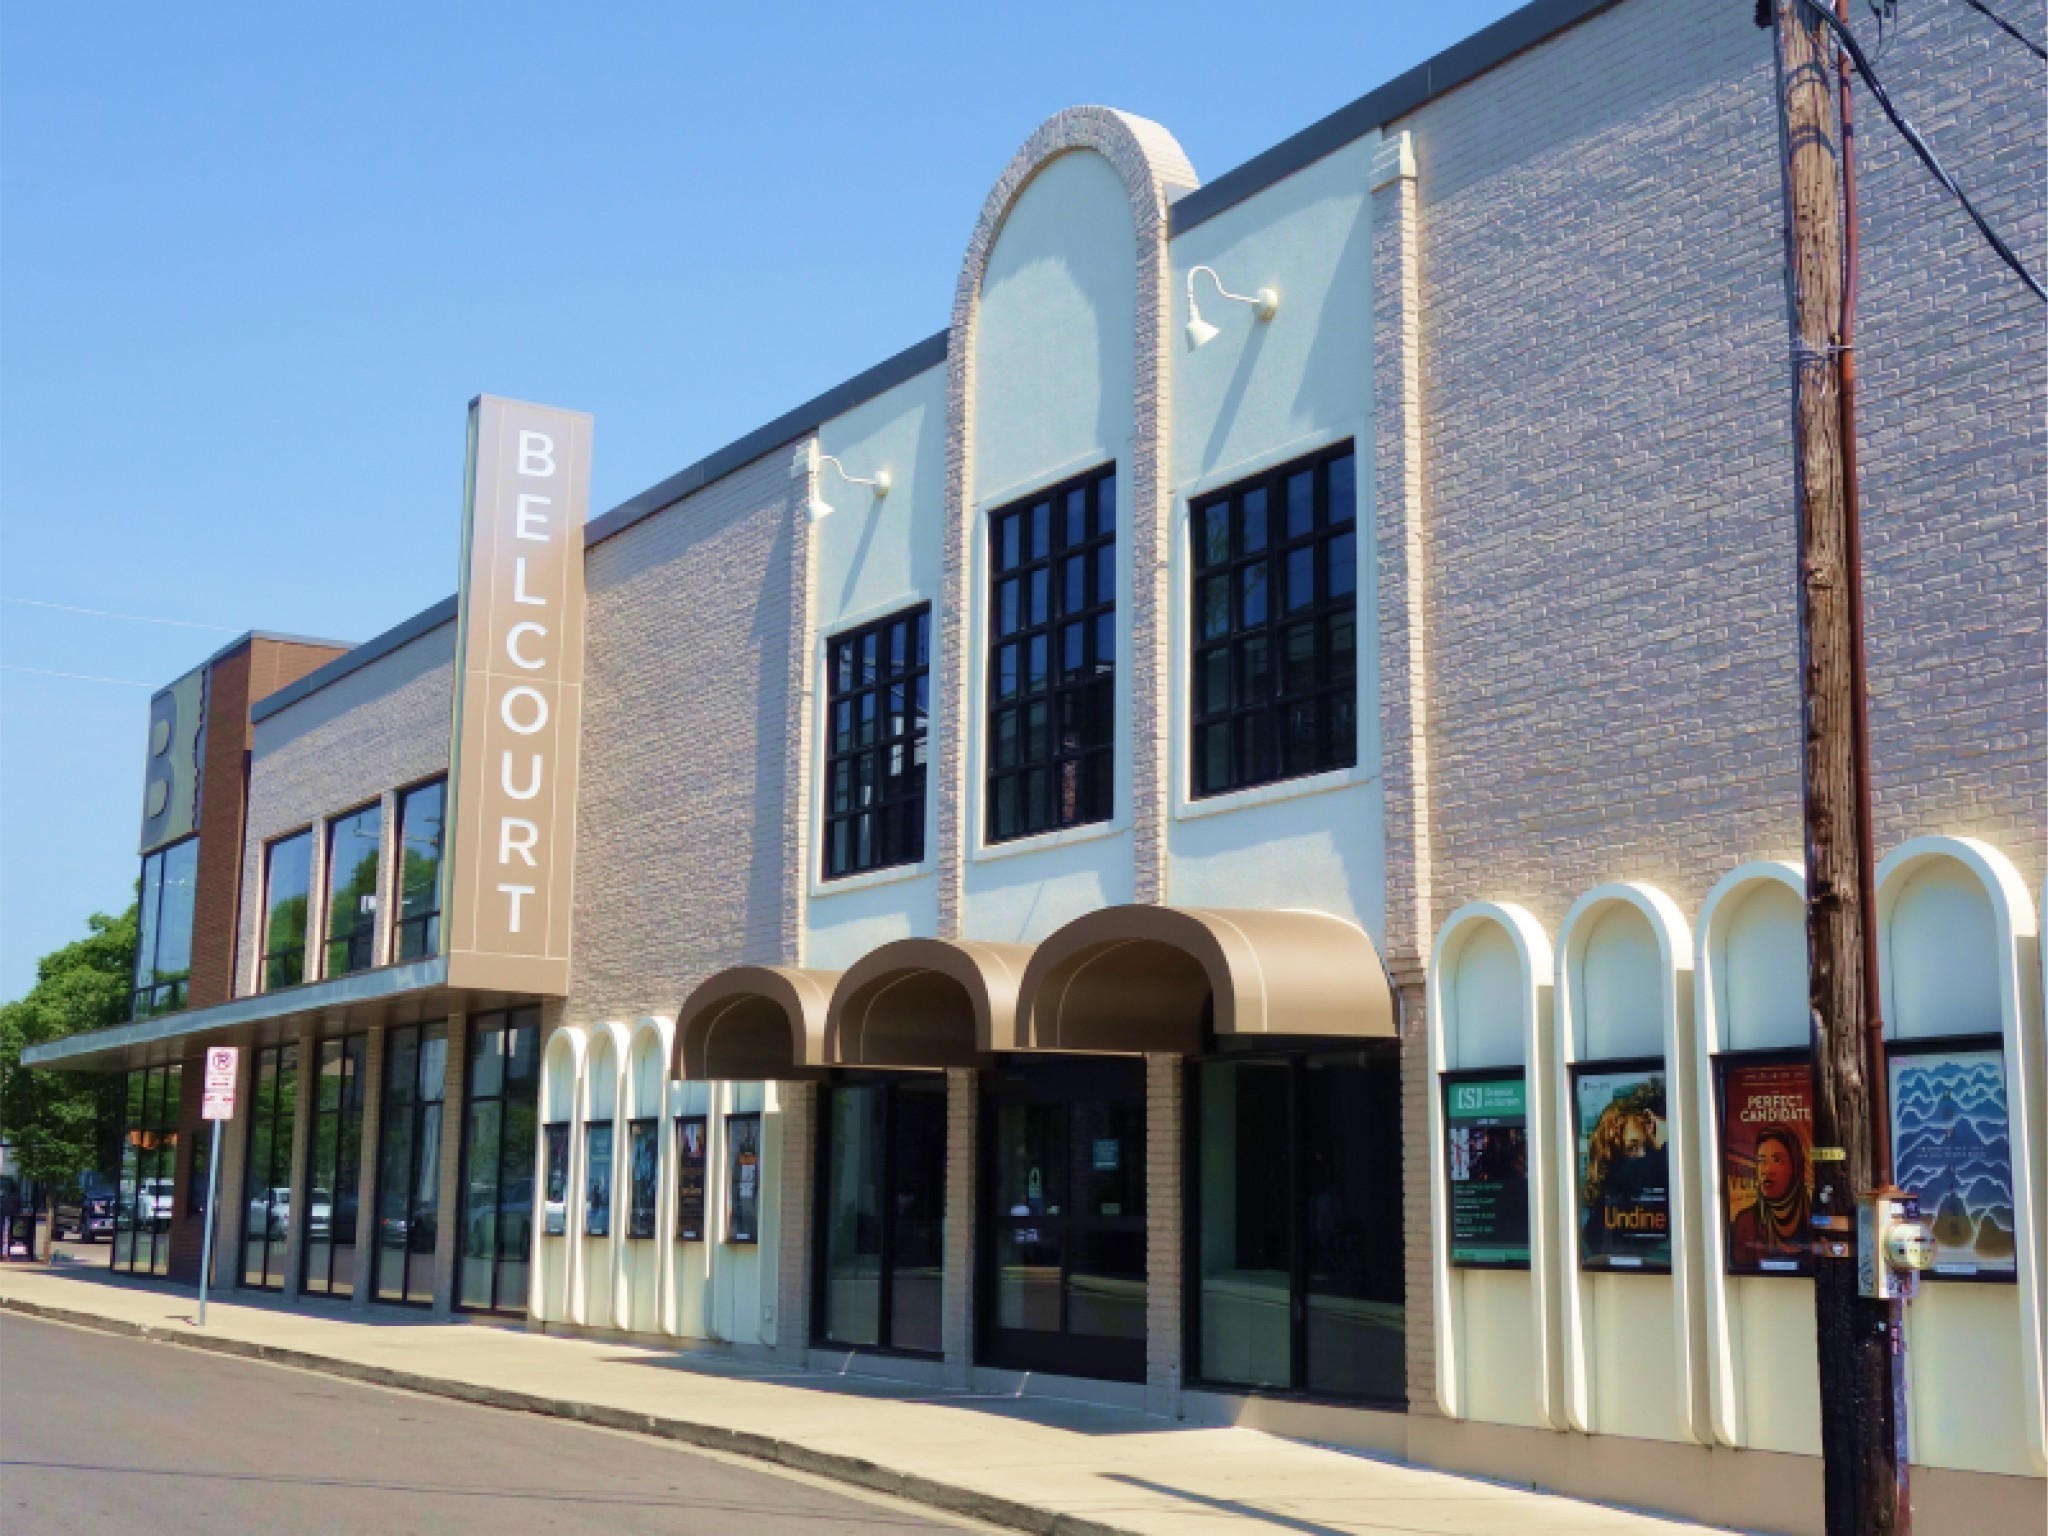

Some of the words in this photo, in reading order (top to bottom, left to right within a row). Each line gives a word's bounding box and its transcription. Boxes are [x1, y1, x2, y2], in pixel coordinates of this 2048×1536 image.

[497, 429, 556, 933] BELCOURT
[1747, 1095, 1803, 1109] PERFECT
[1604, 1205, 1667, 1230] Undine
